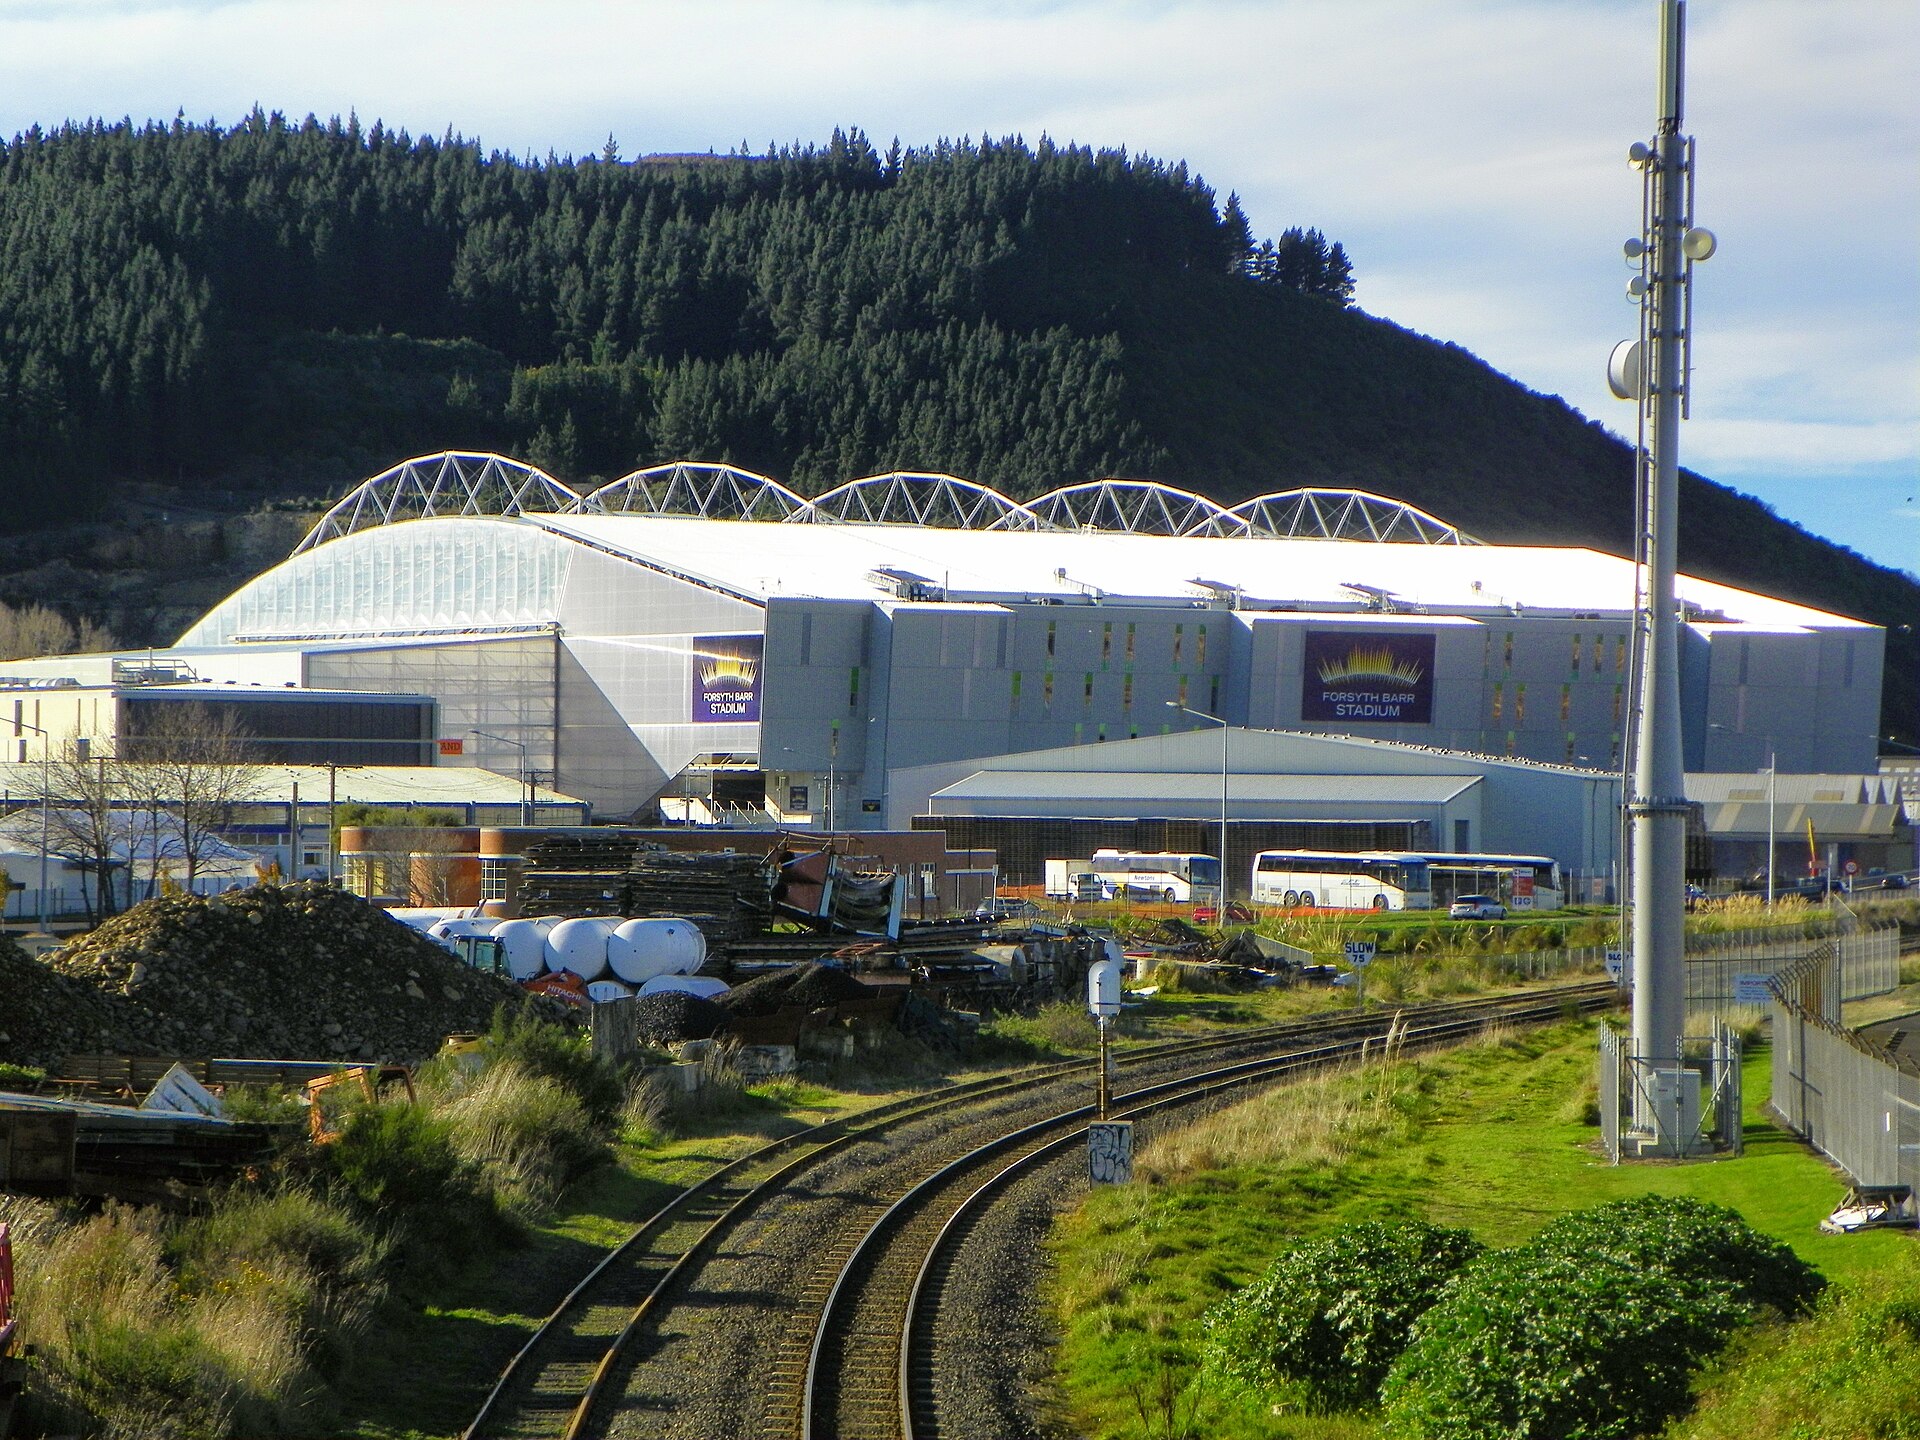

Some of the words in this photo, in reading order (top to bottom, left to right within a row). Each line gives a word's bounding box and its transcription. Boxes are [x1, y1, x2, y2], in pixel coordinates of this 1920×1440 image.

[703, 692, 734, 702] FORSYTH
[735, 692, 753, 701] BARR
[1322, 692, 1379, 702] FORSYTH
[1382, 693, 1415, 703] BARR
[710, 702, 746, 714] STADIUM
[1336, 704, 1400, 716] STADIUM
[1345, 942, 1373, 953] SLOW
[1352, 954, 1365, 962] 75
[1608, 953, 1630, 961] SLO
[547, 984, 582, 1001] HITACHI
